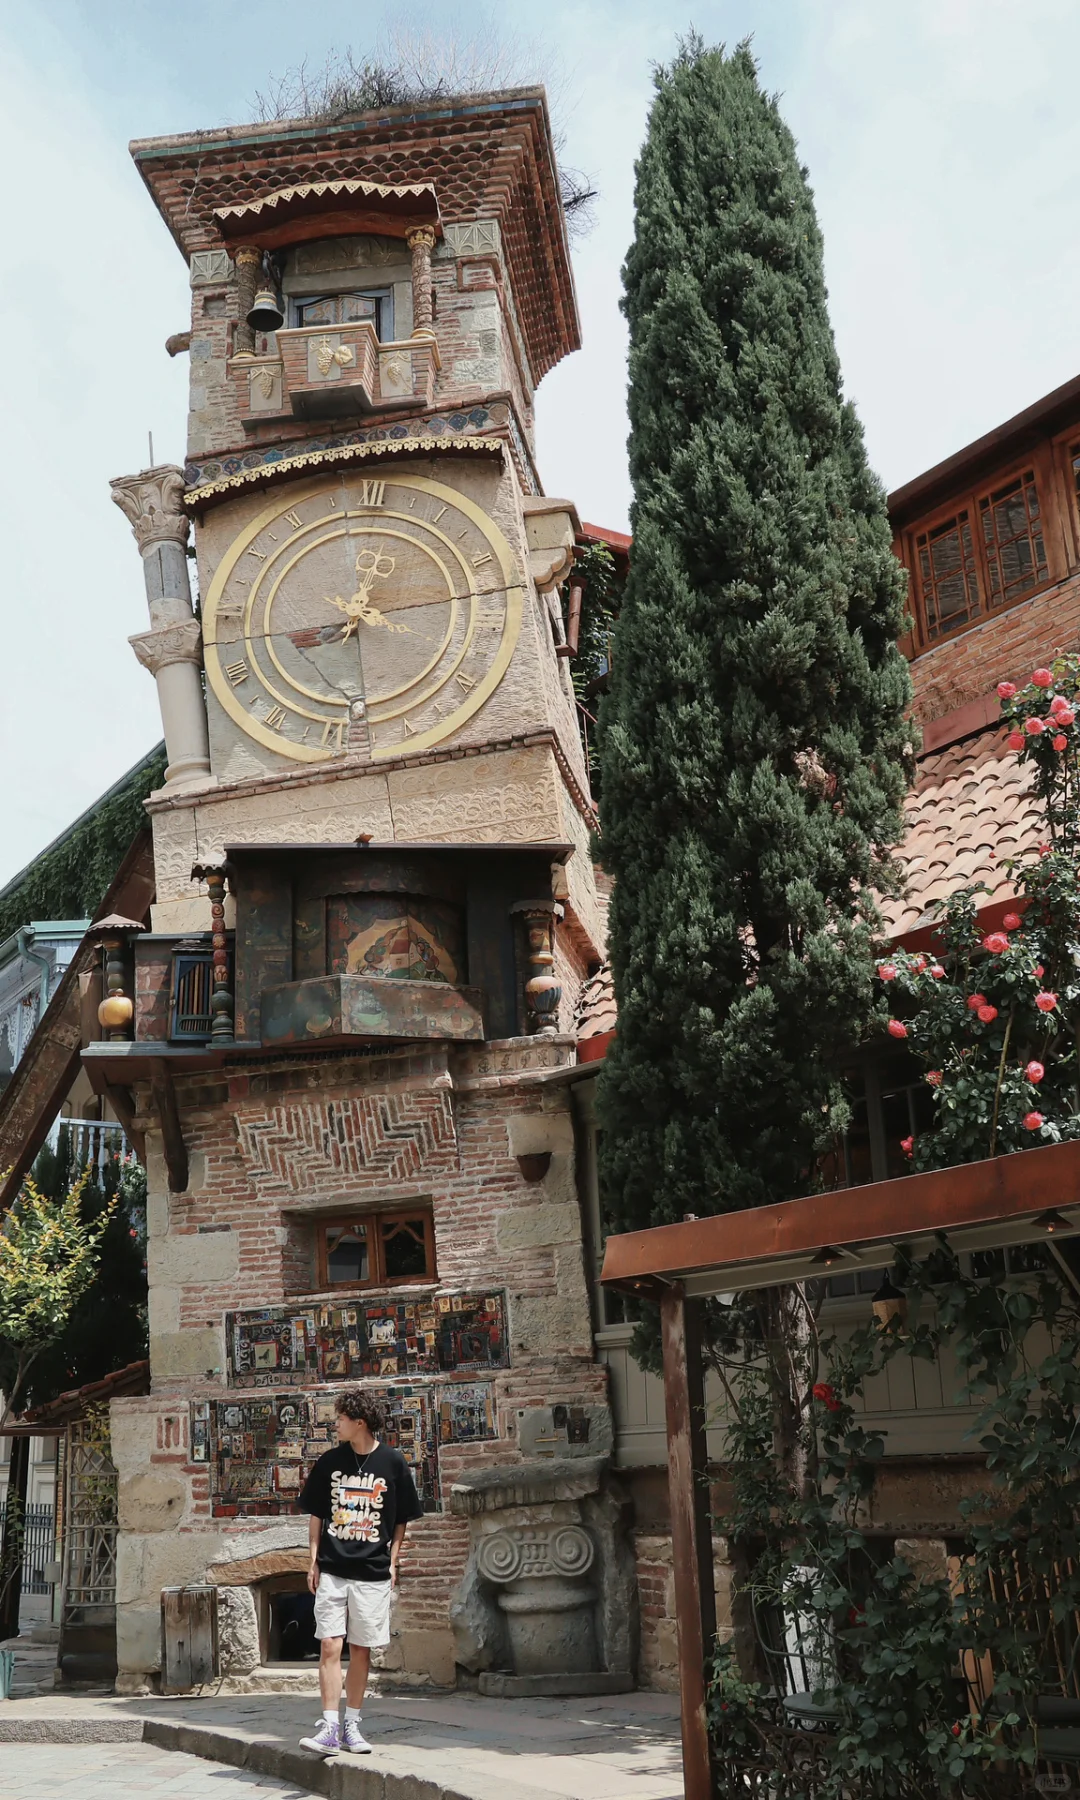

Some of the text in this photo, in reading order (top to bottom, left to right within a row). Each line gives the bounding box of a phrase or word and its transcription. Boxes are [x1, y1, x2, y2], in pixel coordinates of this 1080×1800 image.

[357, 479, 386, 507] XII
[284, 510, 305, 532] XI
[433, 506, 448, 524] I
[247, 546, 267, 563] X
[471, 552, 493, 568] II
[225, 659, 249, 687] VIII
[264, 703, 287, 731] VII
[404, 717, 418, 738] V
